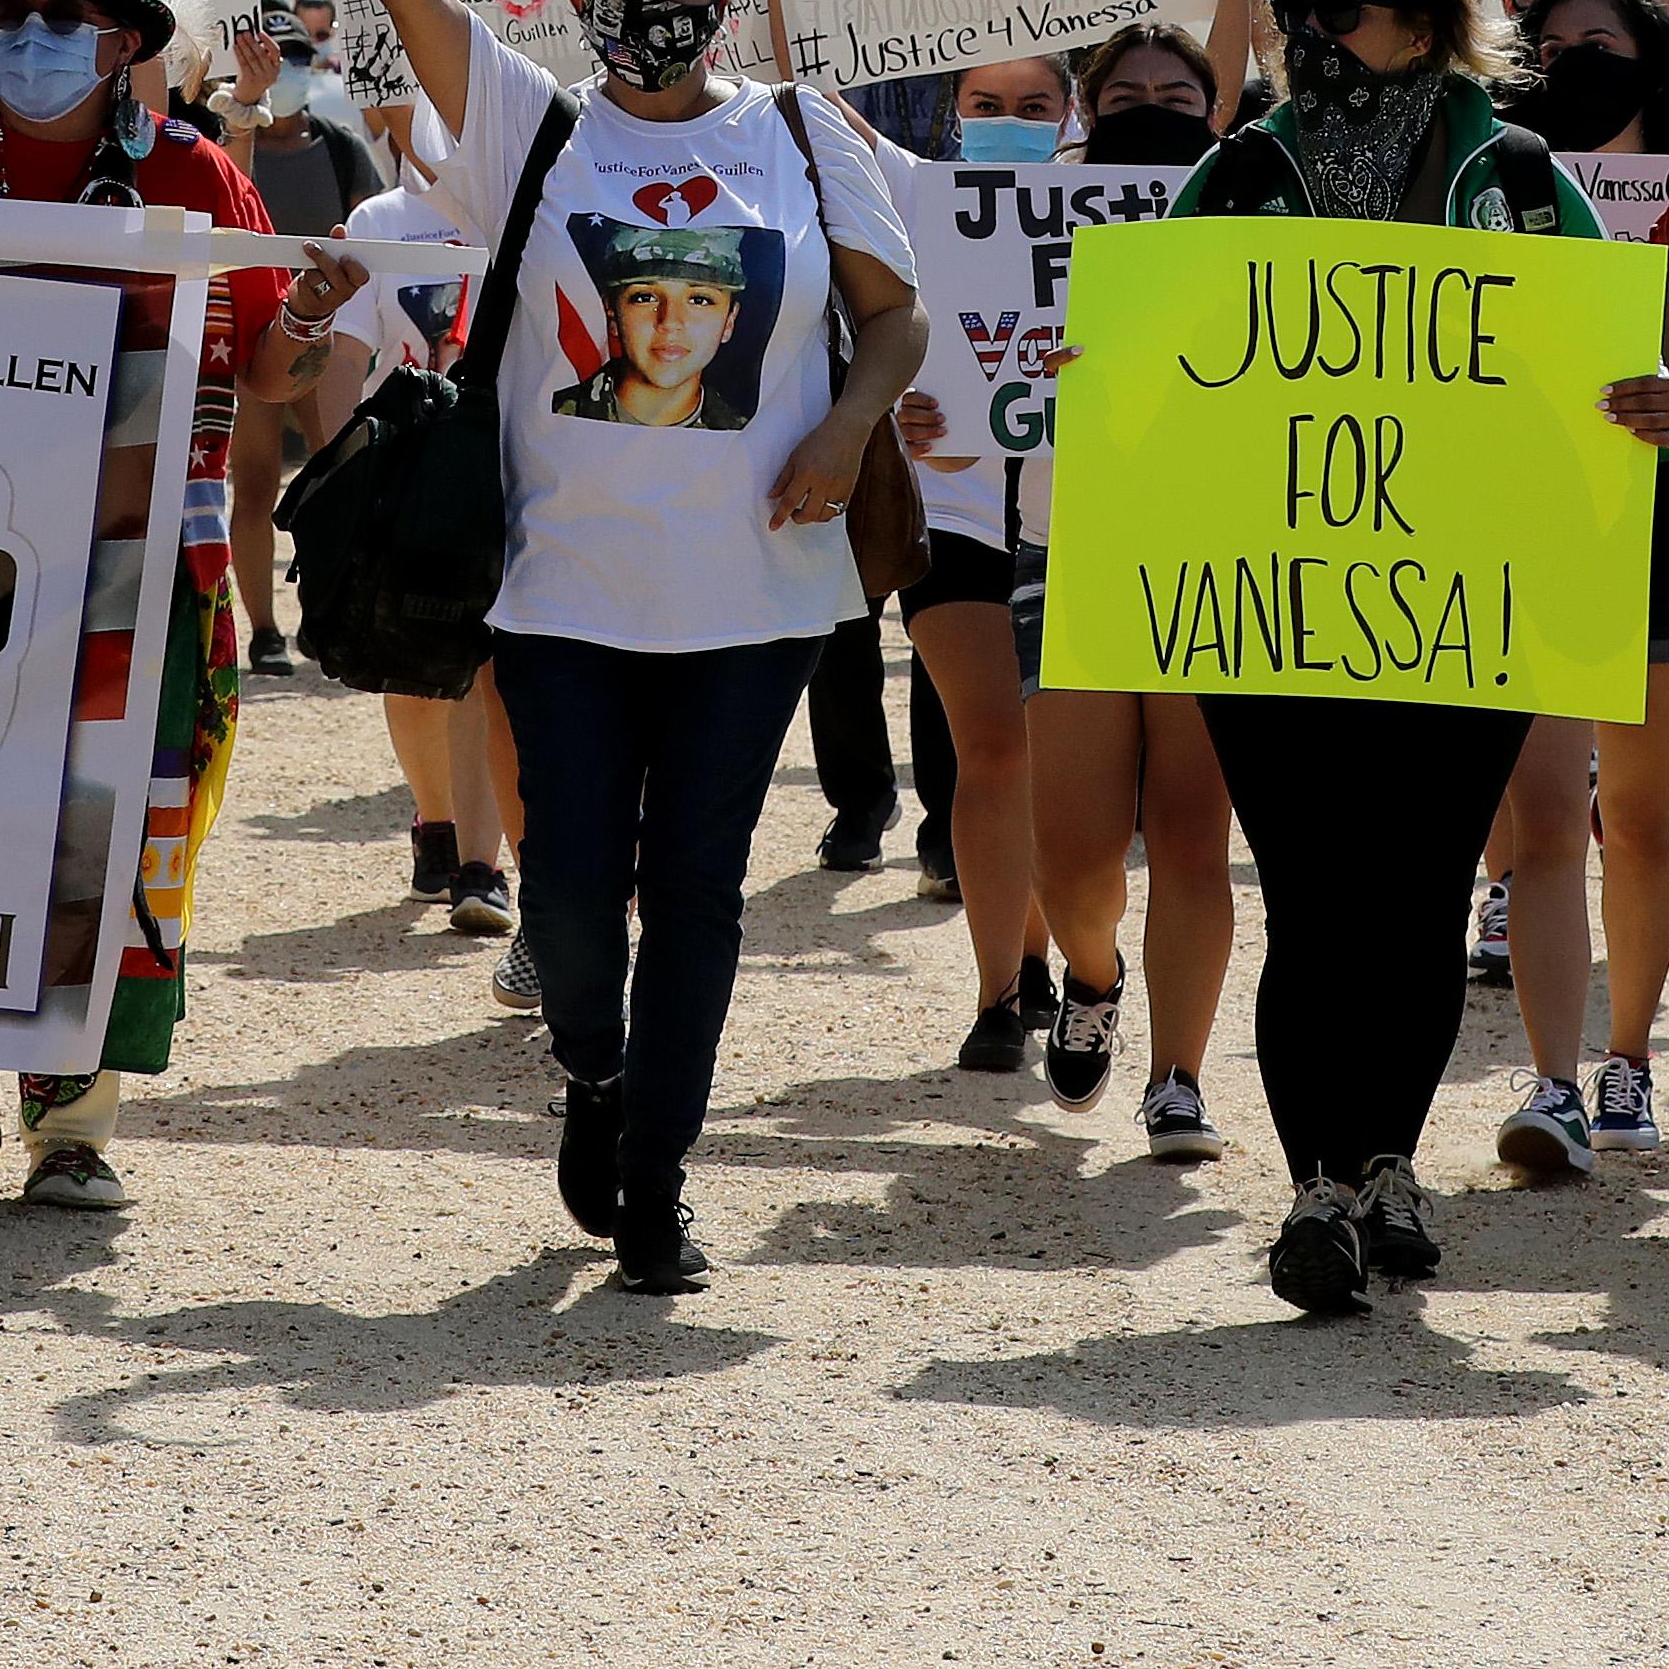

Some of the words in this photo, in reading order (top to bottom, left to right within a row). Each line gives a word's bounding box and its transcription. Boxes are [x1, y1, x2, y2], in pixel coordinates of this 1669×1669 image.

[954, 170, 1169, 240] Justi
[1178, 258, 1515, 388] JUSTICE
[1286, 413, 1414, 534] FOR
[1139, 551, 1512, 688] VANESSA!
